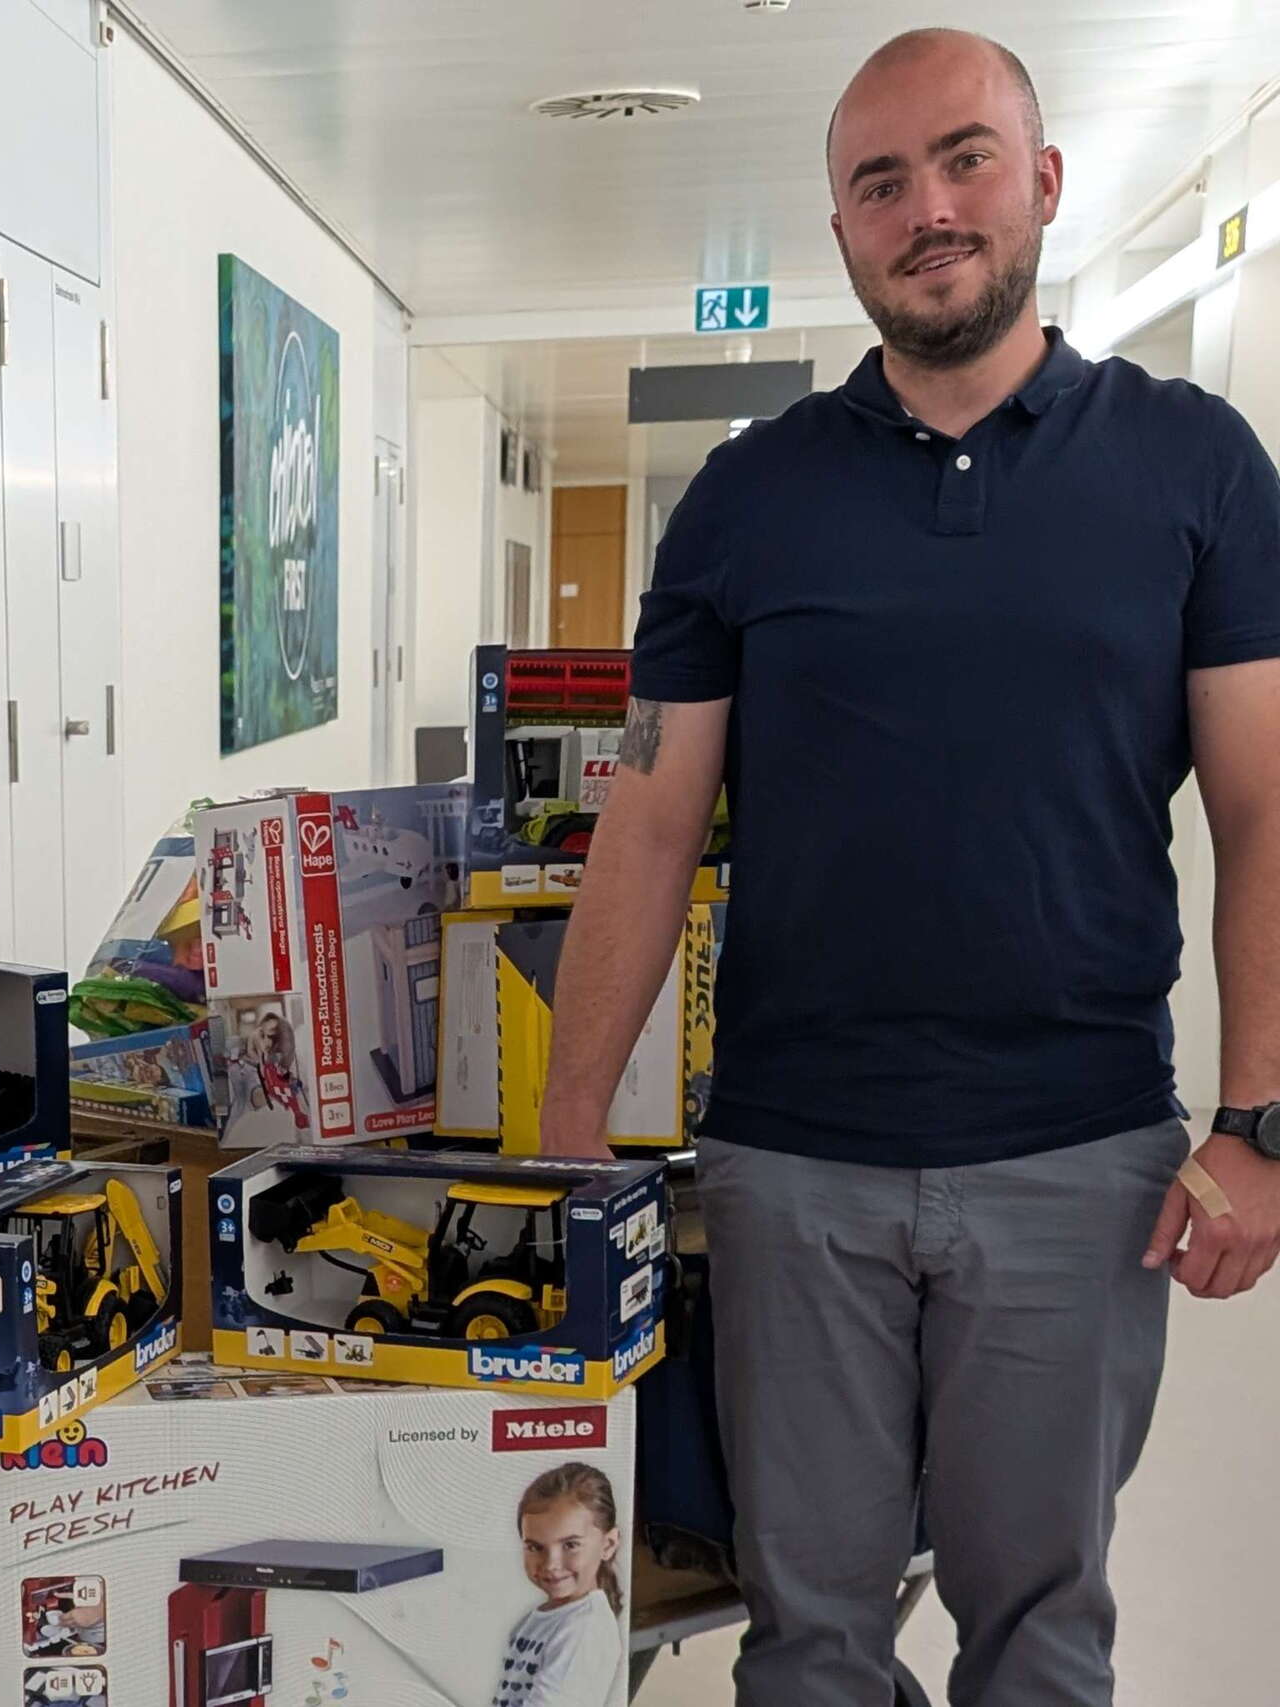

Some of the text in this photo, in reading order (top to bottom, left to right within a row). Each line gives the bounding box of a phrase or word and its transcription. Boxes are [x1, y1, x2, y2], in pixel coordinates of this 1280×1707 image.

[303, 854, 333, 869] Hape
[328, 929, 338, 960] Rega
[312, 922, 333, 1067] Rega-Einsatzbasis
[336, 1038, 345, 1065] Base
[371, 1116, 395, 1129] Love
[396, 1114, 417, 1127] Play
[220, 1221, 235, 1234] 3+
[135, 1328, 176, 1370] bruder
[471, 1347, 580, 1382] bruder
[614, 1330, 655, 1377] bruder
[388, 1420, 595, 1443] Licensed by Miele
[9, 1462, 220, 1524] PLAY KITCHEN
[23, 1508, 135, 1549] FRESH
